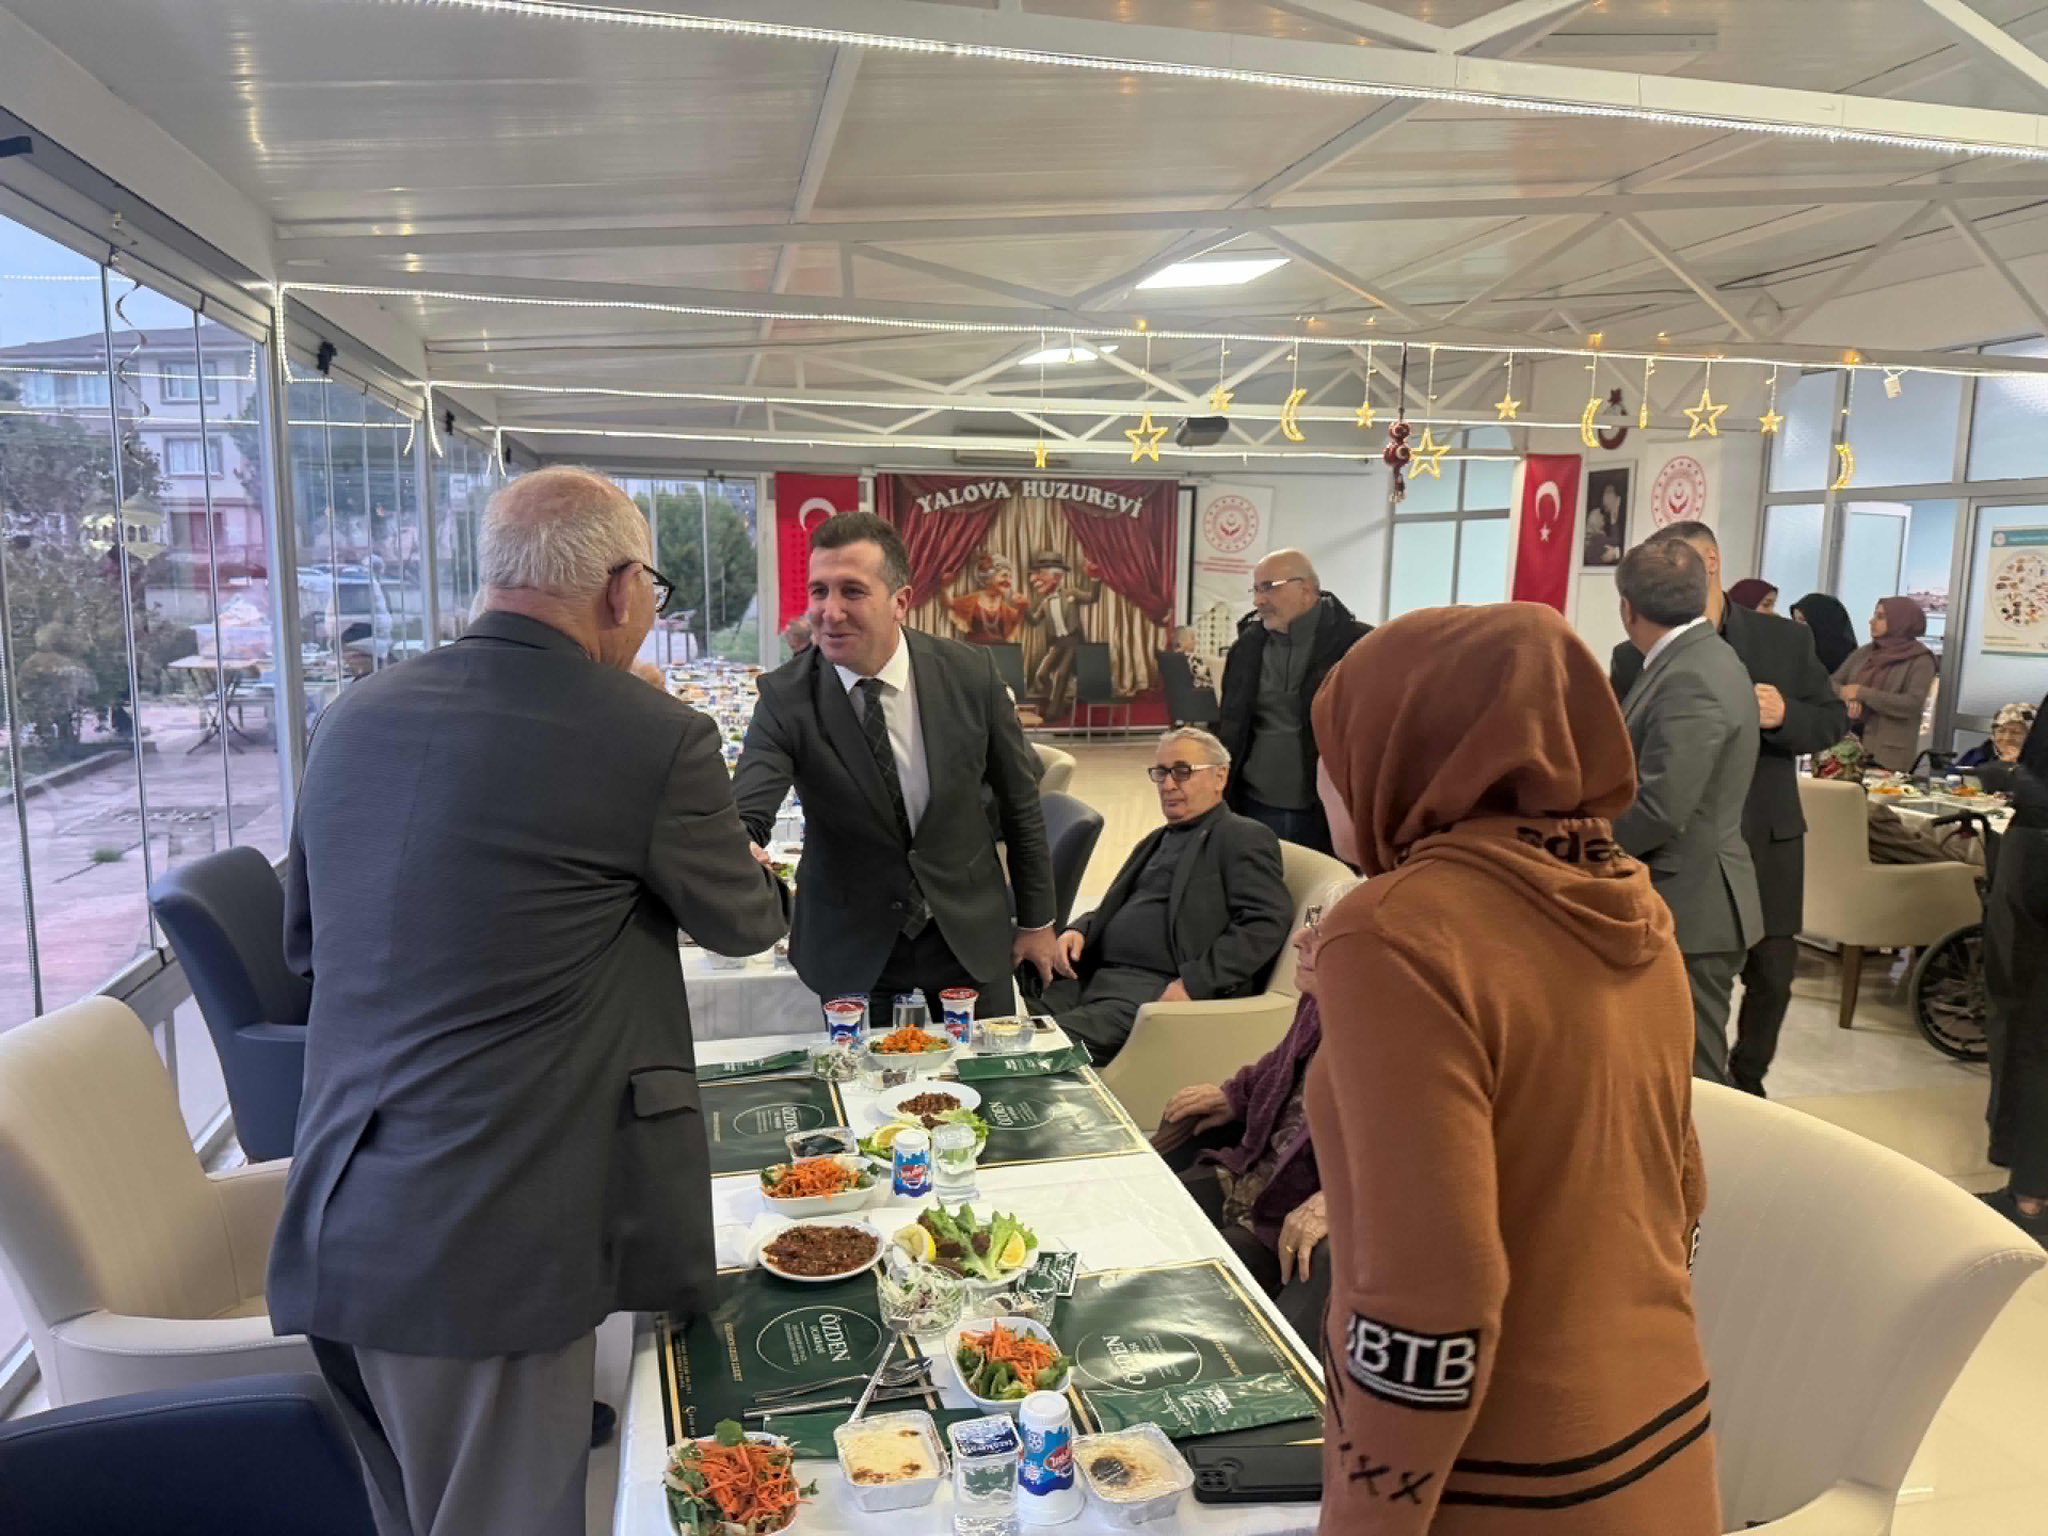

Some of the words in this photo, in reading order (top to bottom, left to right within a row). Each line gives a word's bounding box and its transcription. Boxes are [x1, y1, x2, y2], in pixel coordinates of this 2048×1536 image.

[916, 480, 1011, 513] YALOVA
[1022, 480, 1143, 519] HUZUREVİ
[818, 1313, 851, 1362] ÖZDEN
